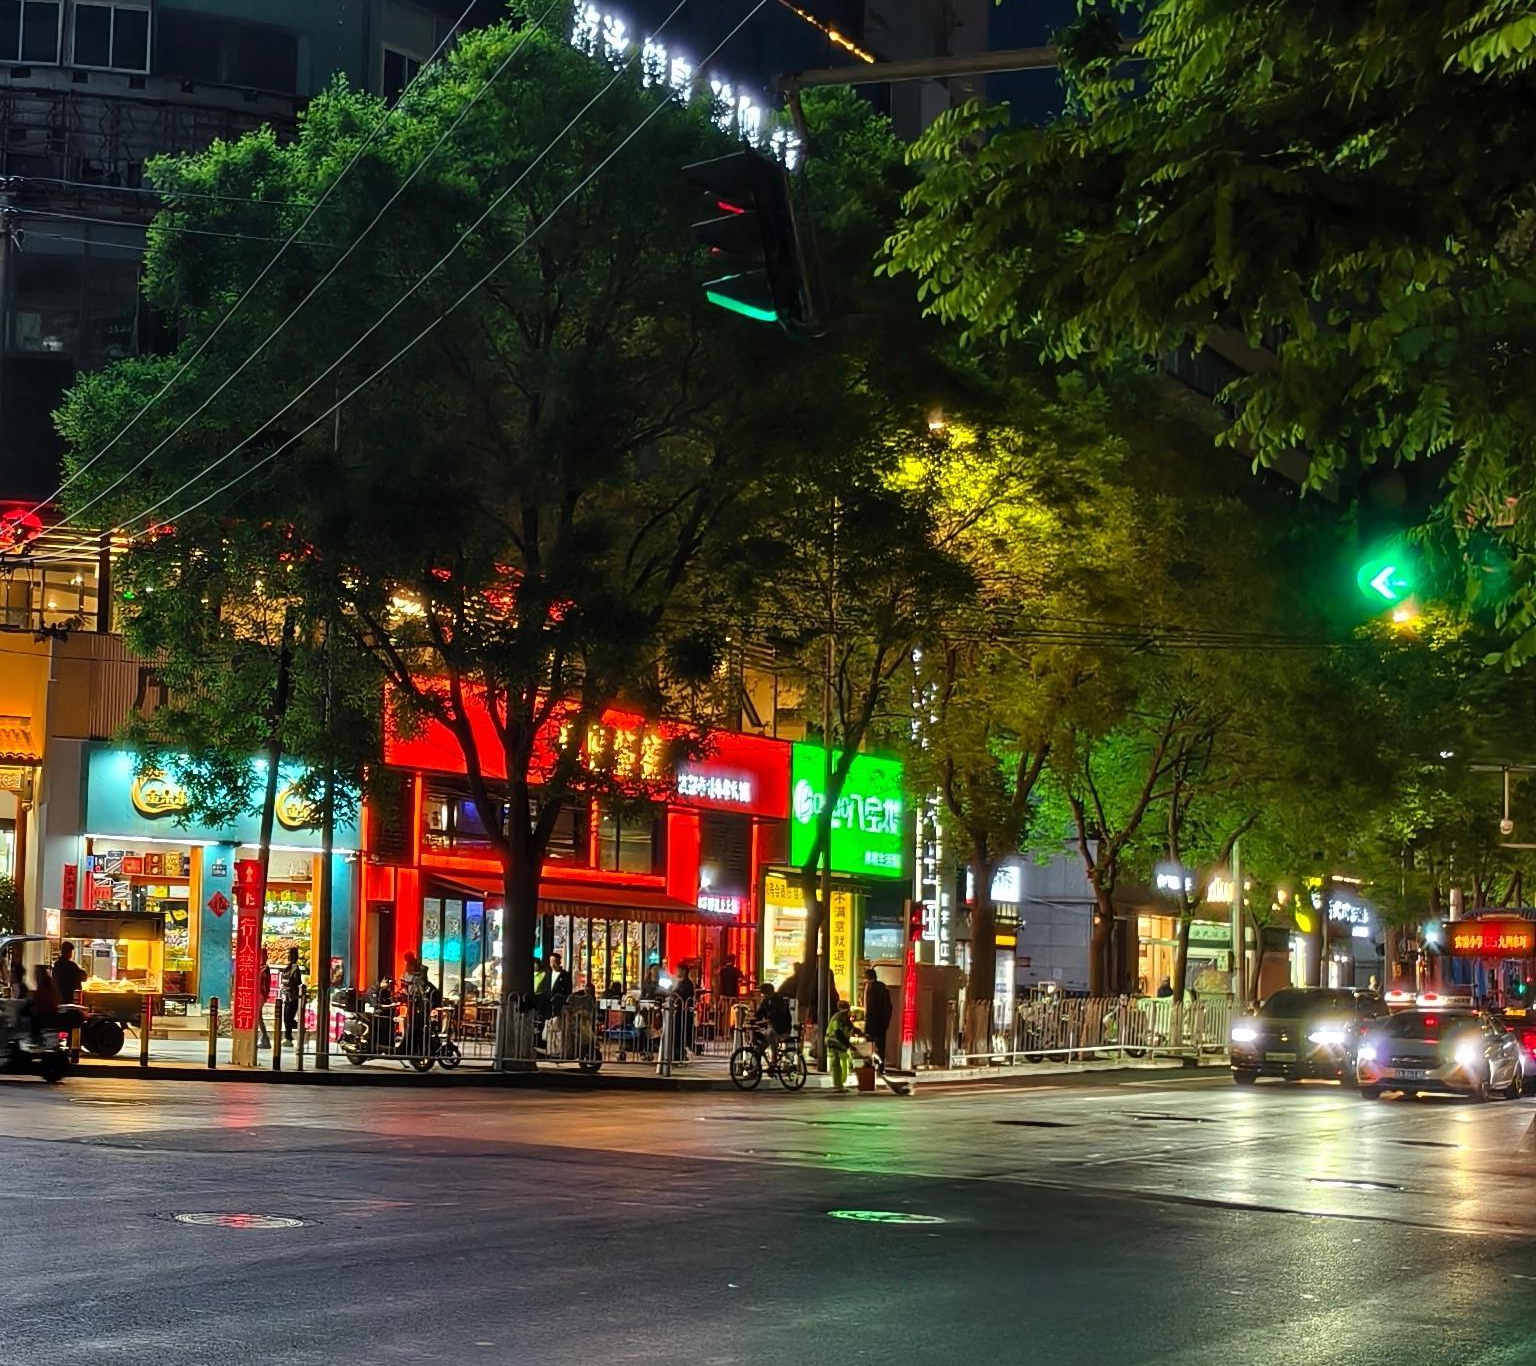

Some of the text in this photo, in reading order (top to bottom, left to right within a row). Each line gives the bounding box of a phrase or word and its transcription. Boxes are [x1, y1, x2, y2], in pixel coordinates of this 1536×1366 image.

[235, 918, 258, 1030] 行人禁止通行
